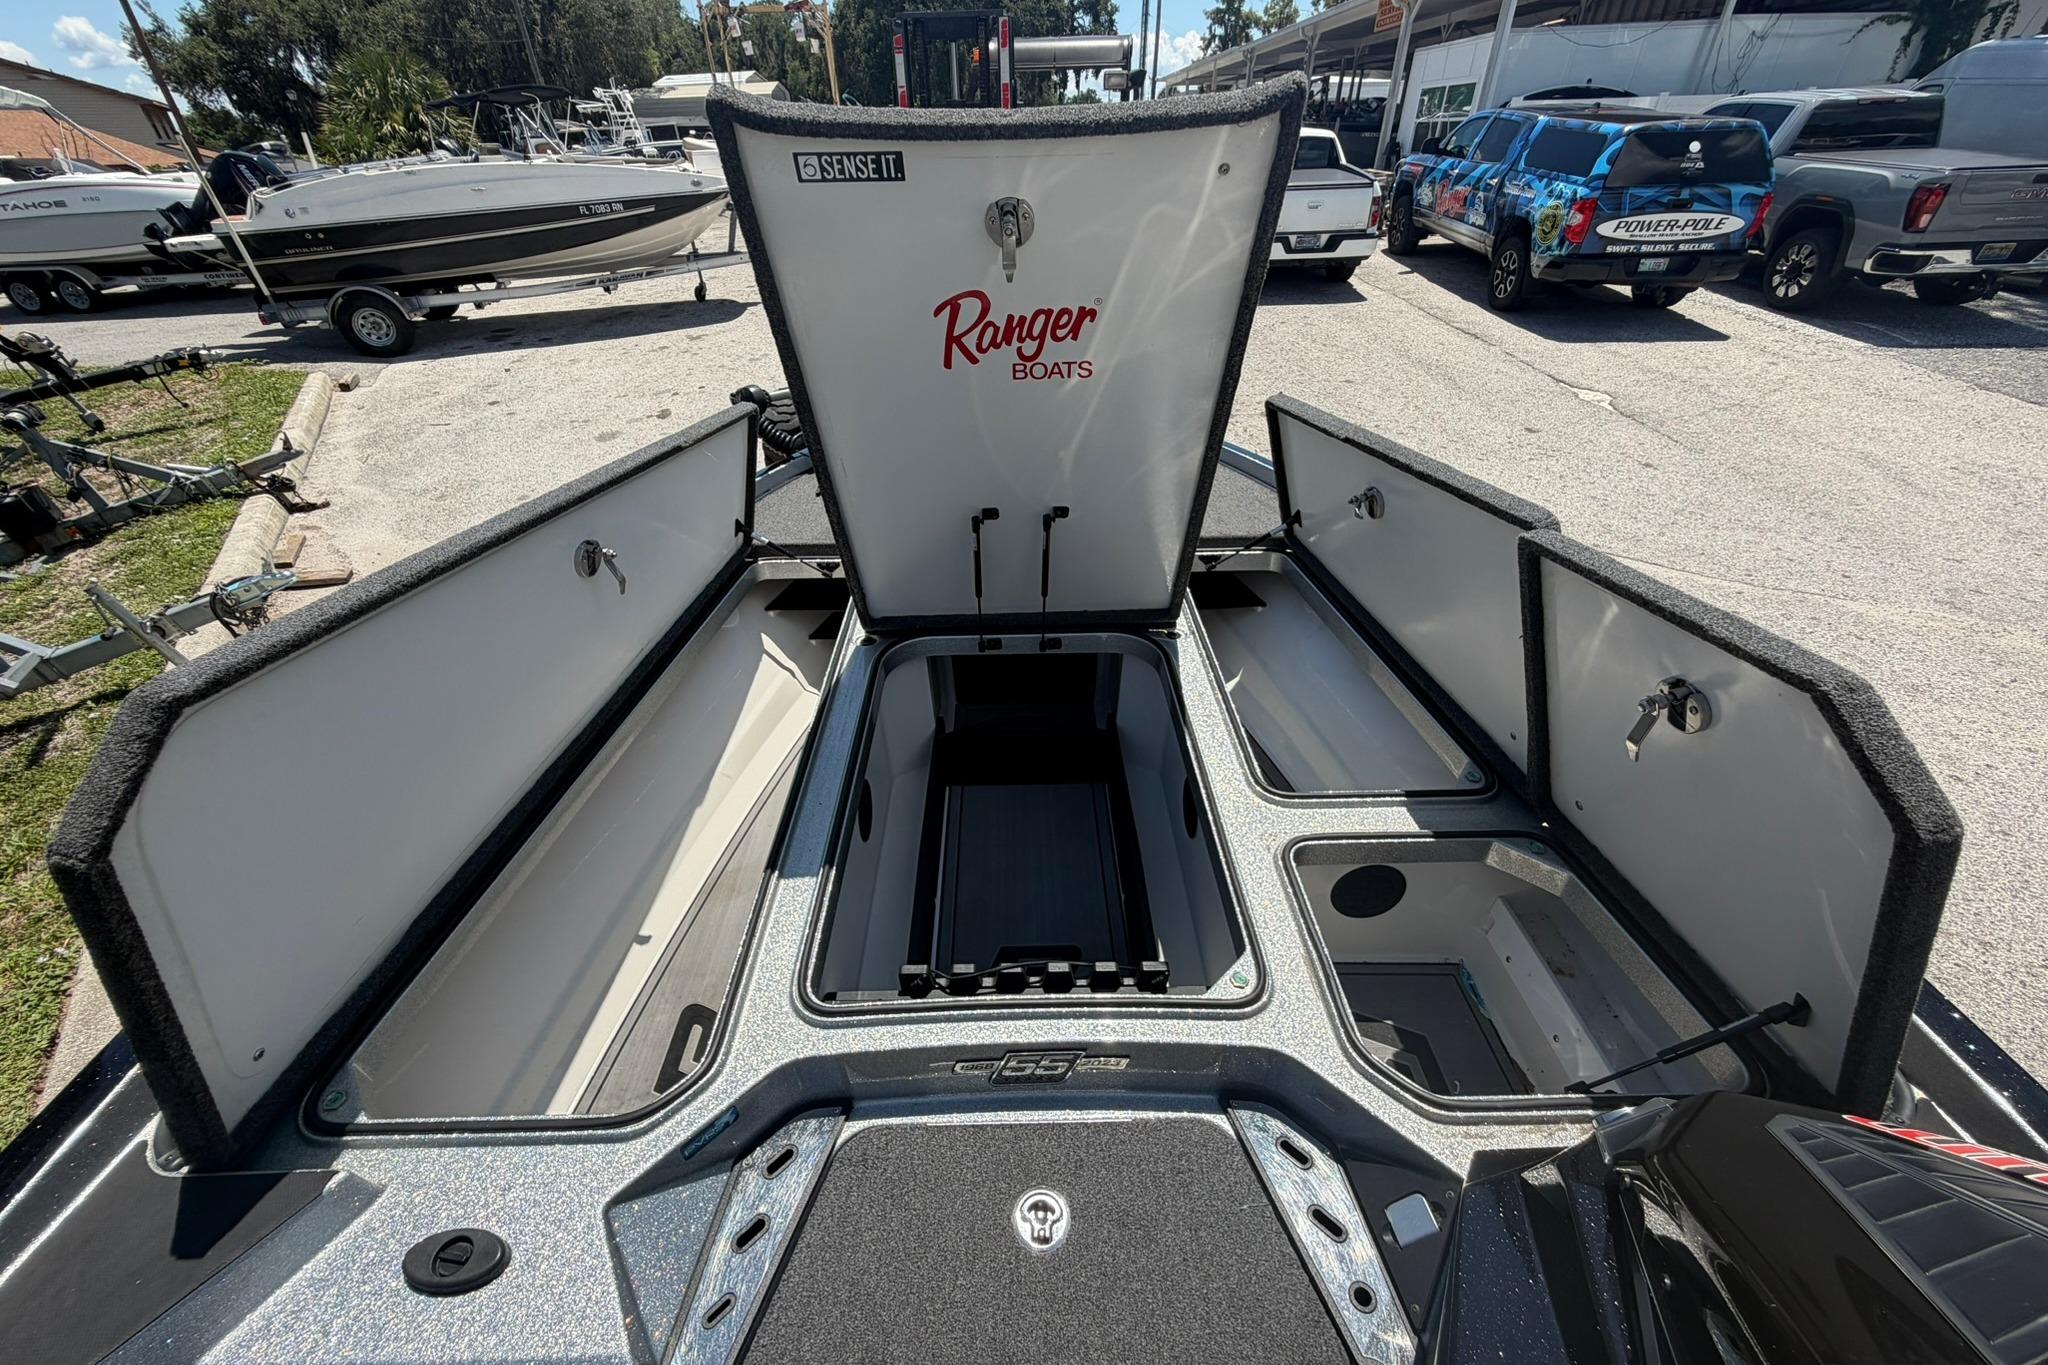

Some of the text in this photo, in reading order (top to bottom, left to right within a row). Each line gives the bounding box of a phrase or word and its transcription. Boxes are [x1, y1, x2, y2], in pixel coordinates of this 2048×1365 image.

[821, 154, 879, 179] SENSE
[881, 154, 902, 178] IT.
[0, 200, 68, 211] TAHOE
[579, 202, 624, 215] FL 7083 RN
[1612, 216, 1730, 233] POWER-POLE
[1605, 242, 1716, 253] SWIFT. SILENT. SECURE.
[933, 289, 1098, 370] Ranger
[1012, 360, 1093, 380] BOATS
[958, 1054, 1122, 1076] 1968 55 2023
